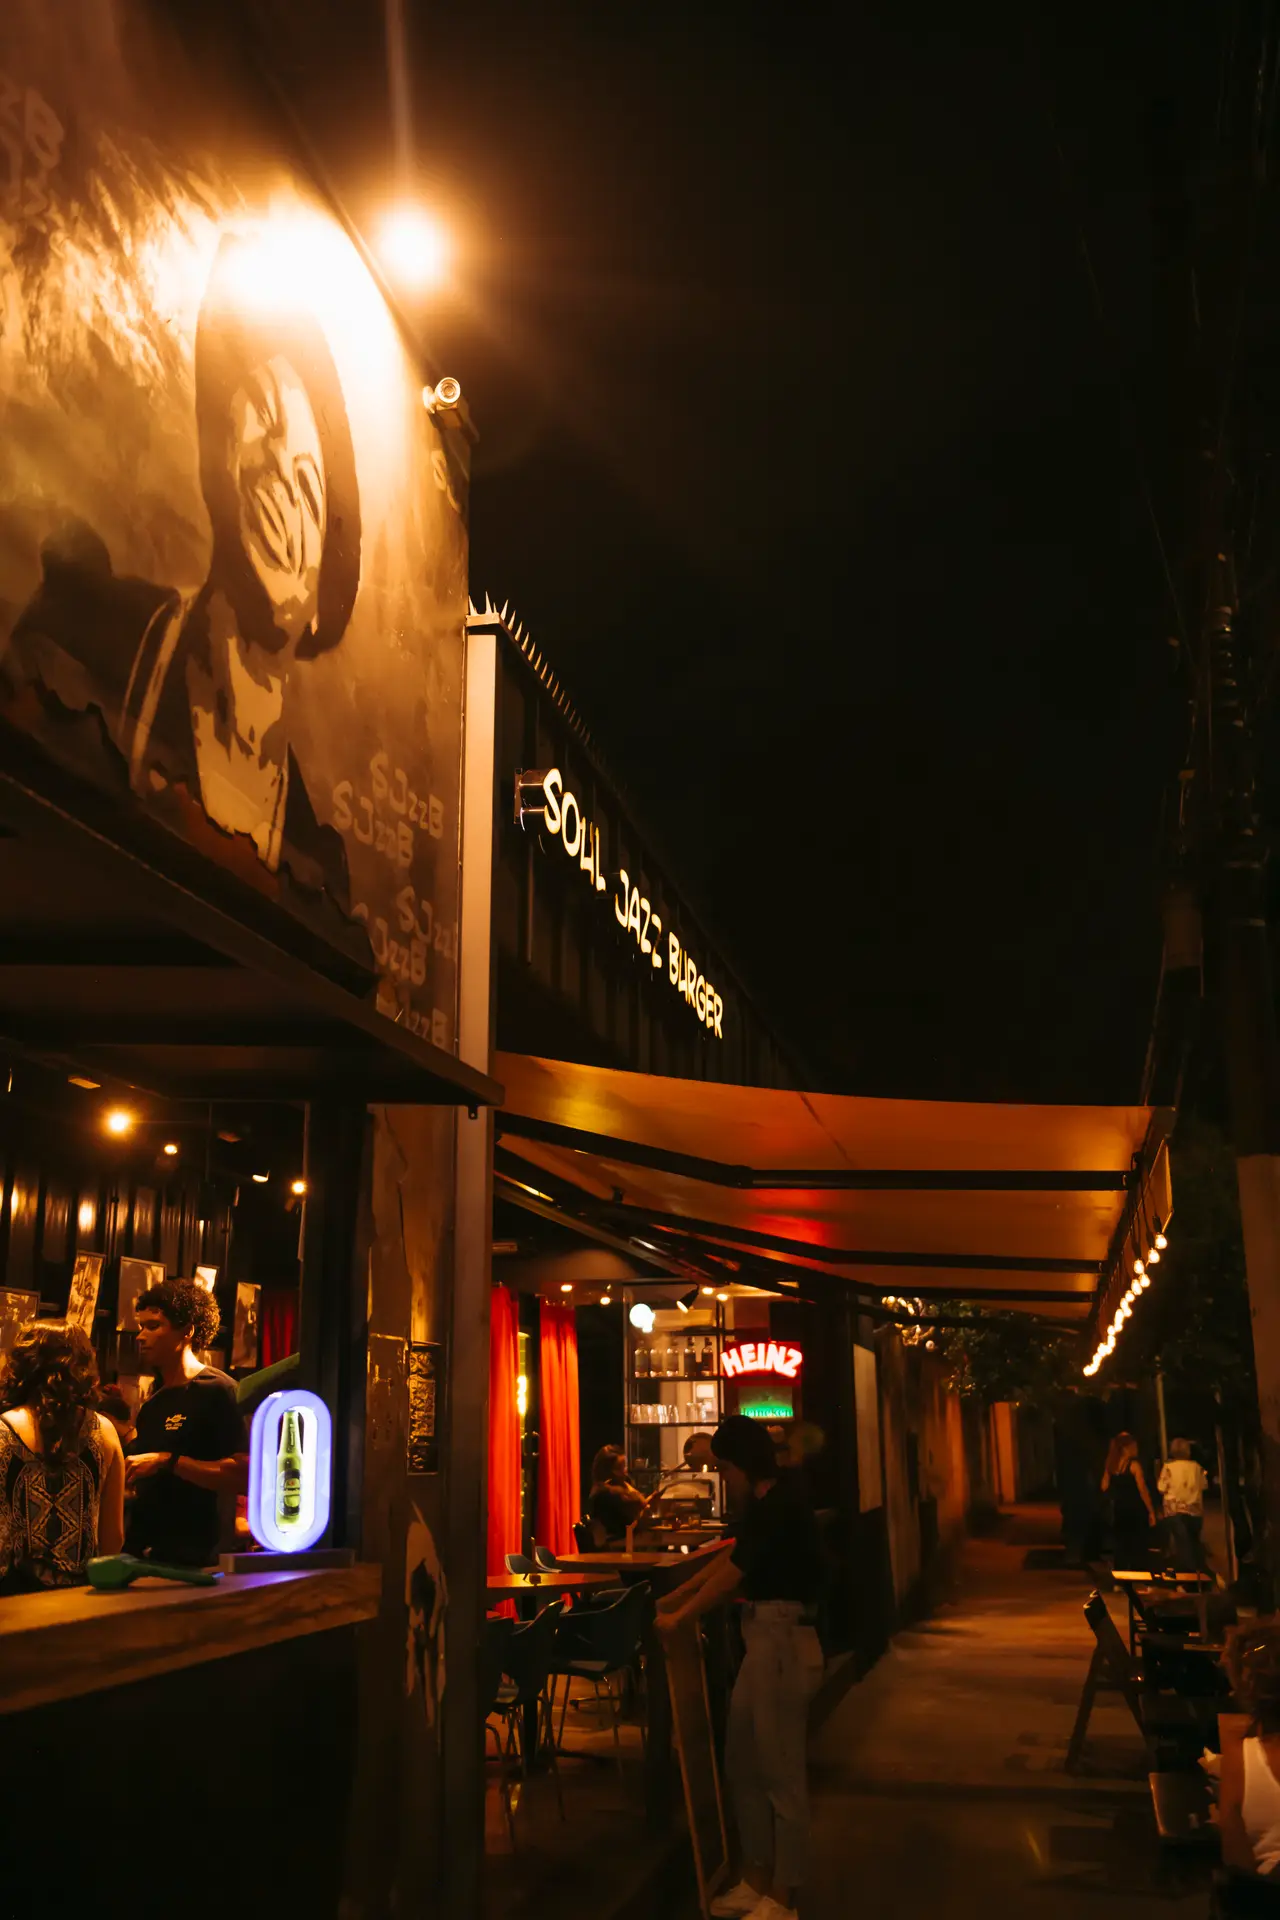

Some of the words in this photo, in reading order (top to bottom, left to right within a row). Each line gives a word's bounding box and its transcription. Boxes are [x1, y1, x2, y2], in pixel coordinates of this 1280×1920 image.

[543, 767, 607, 892] SOUL
[614, 868, 663, 969] JAZZ
[668, 931, 724, 1040] BURGER
[720, 1342, 803, 1378] HEINZ
